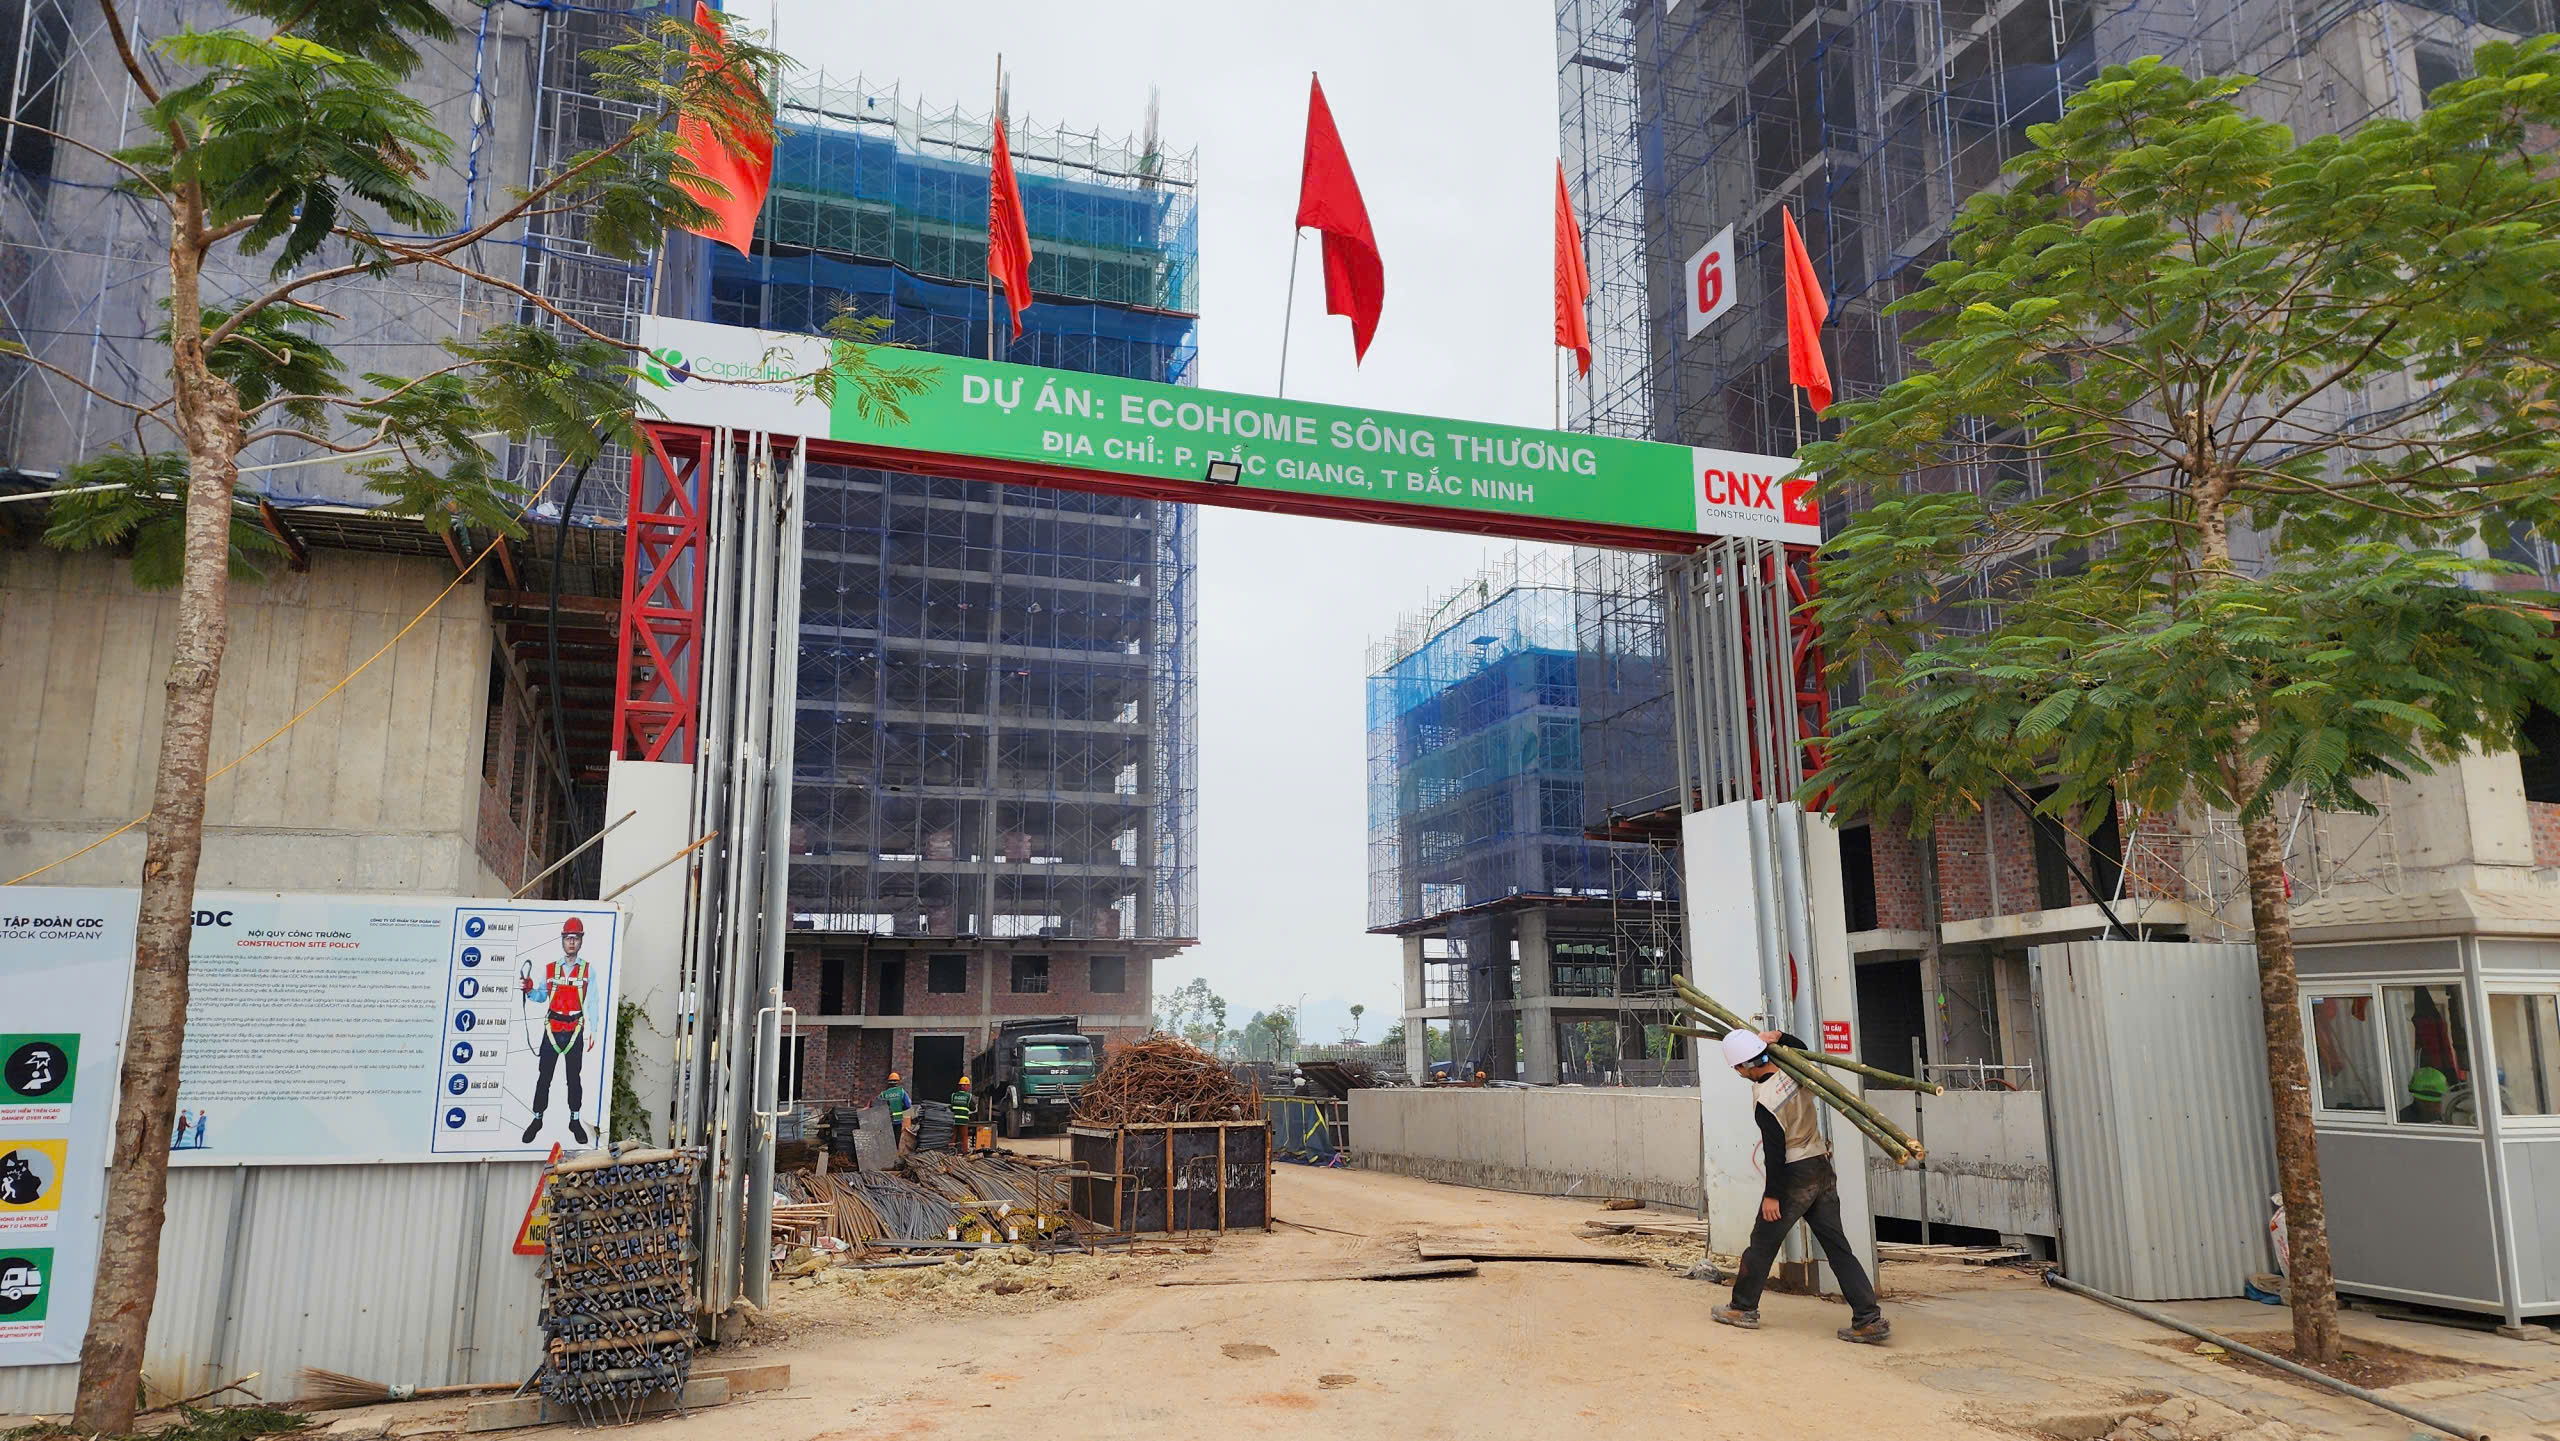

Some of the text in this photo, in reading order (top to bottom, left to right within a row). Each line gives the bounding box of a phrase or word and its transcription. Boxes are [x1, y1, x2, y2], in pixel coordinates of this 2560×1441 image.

[1698, 251, 1722, 313] 6
[962, 374, 1597, 475] DỰ ÁN: ECOHOME SÔNG THƯƠNG
[1042, 430, 1095, 459] ĐỊA
[1103, 434, 1165, 465] CHỈ:
[1175, 446, 1197, 468] P.
[1276, 458, 1374, 490] GIANG,
[1381, 469, 1398, 488] T
[1407, 466, 1462, 495] BẮC
[1471, 476, 1534, 503] NINH
[1705, 469, 1775, 510] CNX
[1706, 508, 1780, 524] CONSTRUCTION
[3, 916, 103, 930] TẬP ĐOÀN GDC
[0, 931, 102, 940] TOCK COMPANY
[248, 929, 352, 939] NỘI QUY CÔNG TRƯỜNG
[237, 940, 305, 948] CONSTRUCTION
